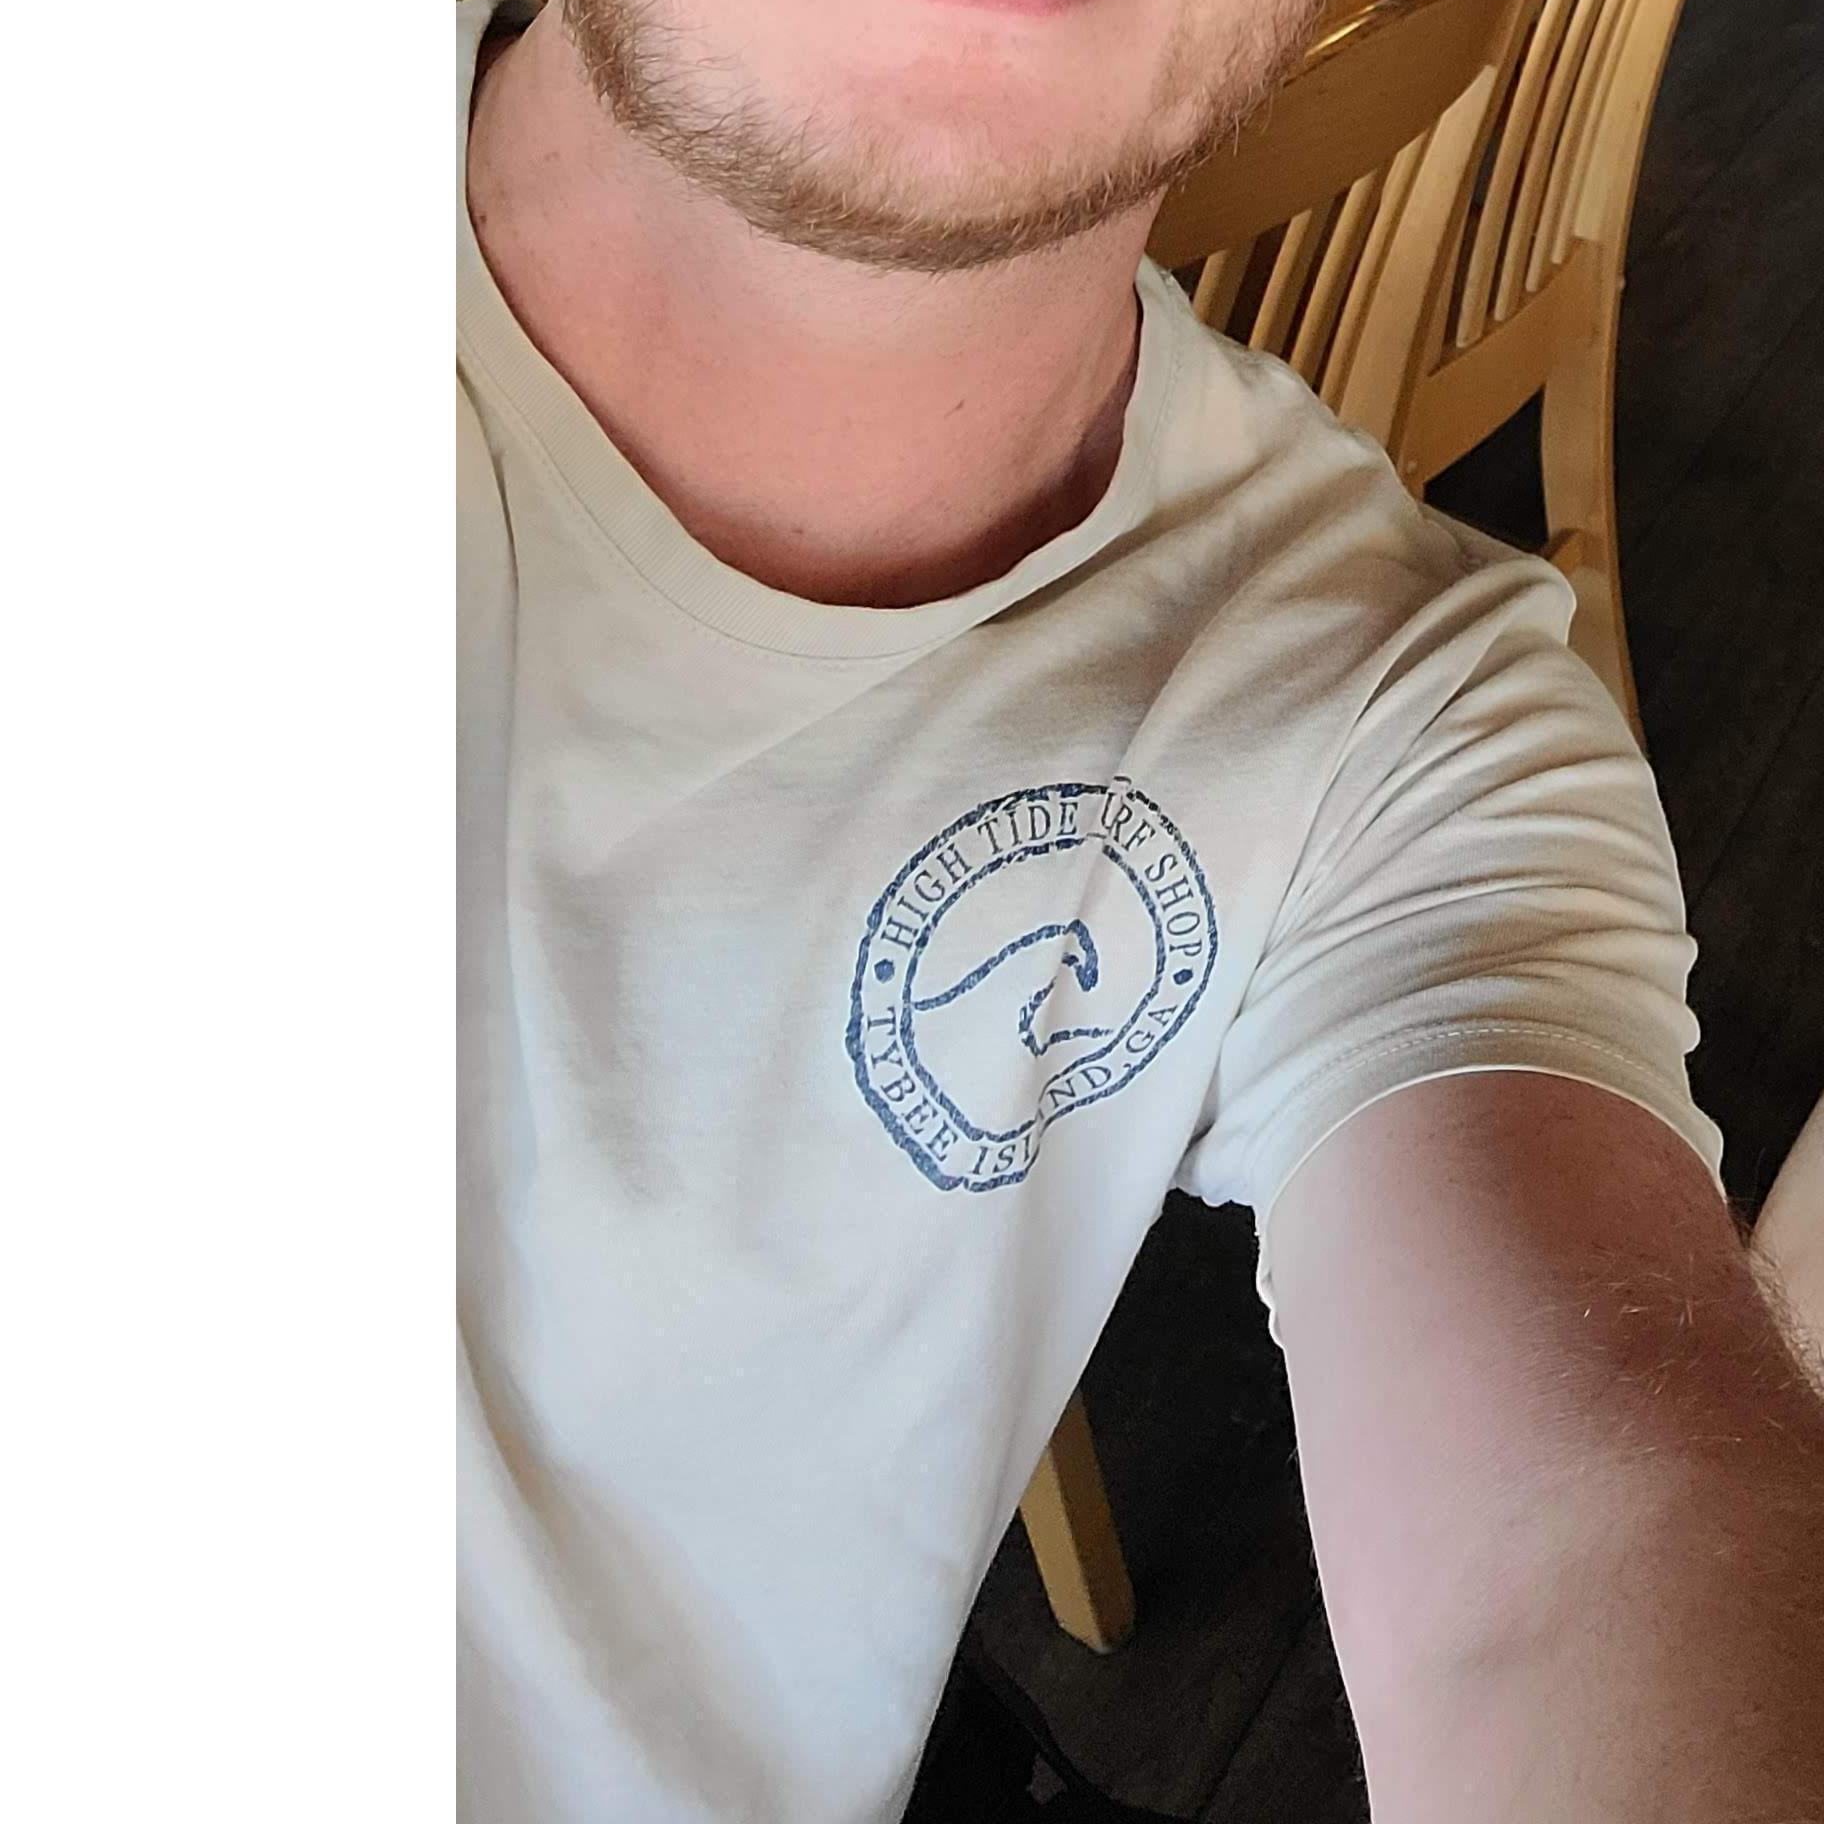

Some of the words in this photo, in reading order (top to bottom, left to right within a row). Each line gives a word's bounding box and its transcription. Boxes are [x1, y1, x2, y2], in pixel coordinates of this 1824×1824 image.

[880, 845, 972, 950] HIGH
[977, 801, 1080, 856] TIDE
[1144, 855, 1203, 959] SHOP
[867, 1005, 959, 1162] TYBEE
